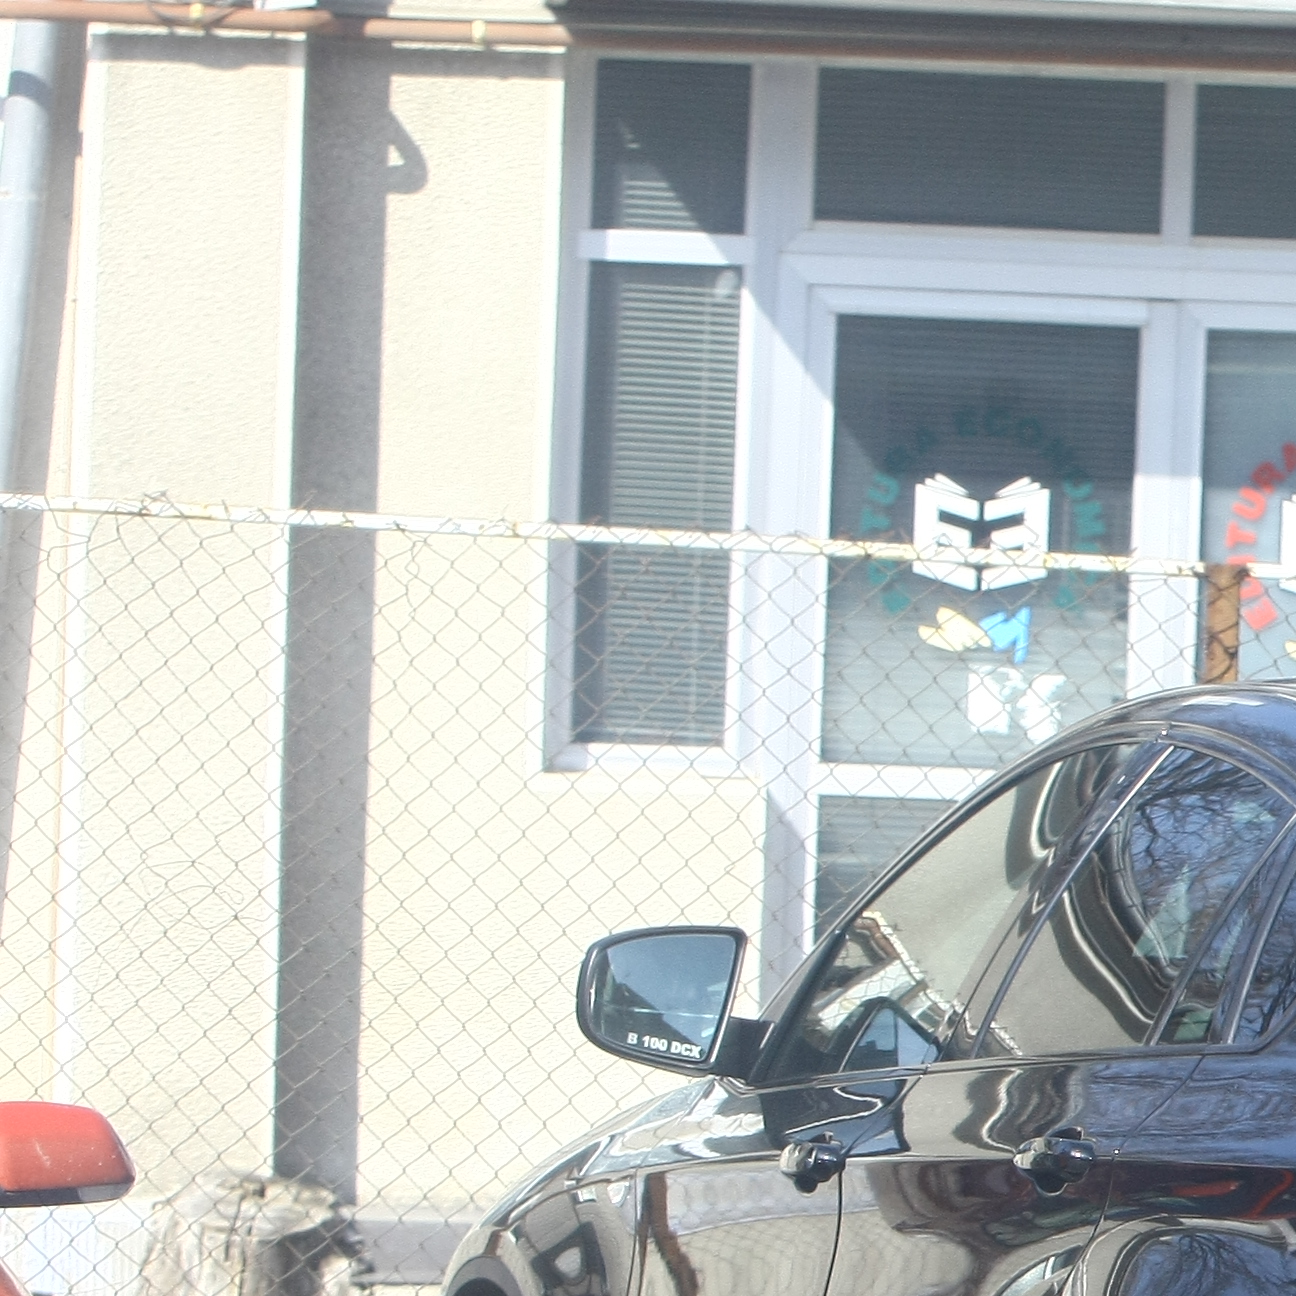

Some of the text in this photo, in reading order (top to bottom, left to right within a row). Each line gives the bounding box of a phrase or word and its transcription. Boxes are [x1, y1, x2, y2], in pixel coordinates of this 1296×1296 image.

[859, 426, 939, 614] EDTURA
[626, 1032, 702, 1059] B 100 DCX
